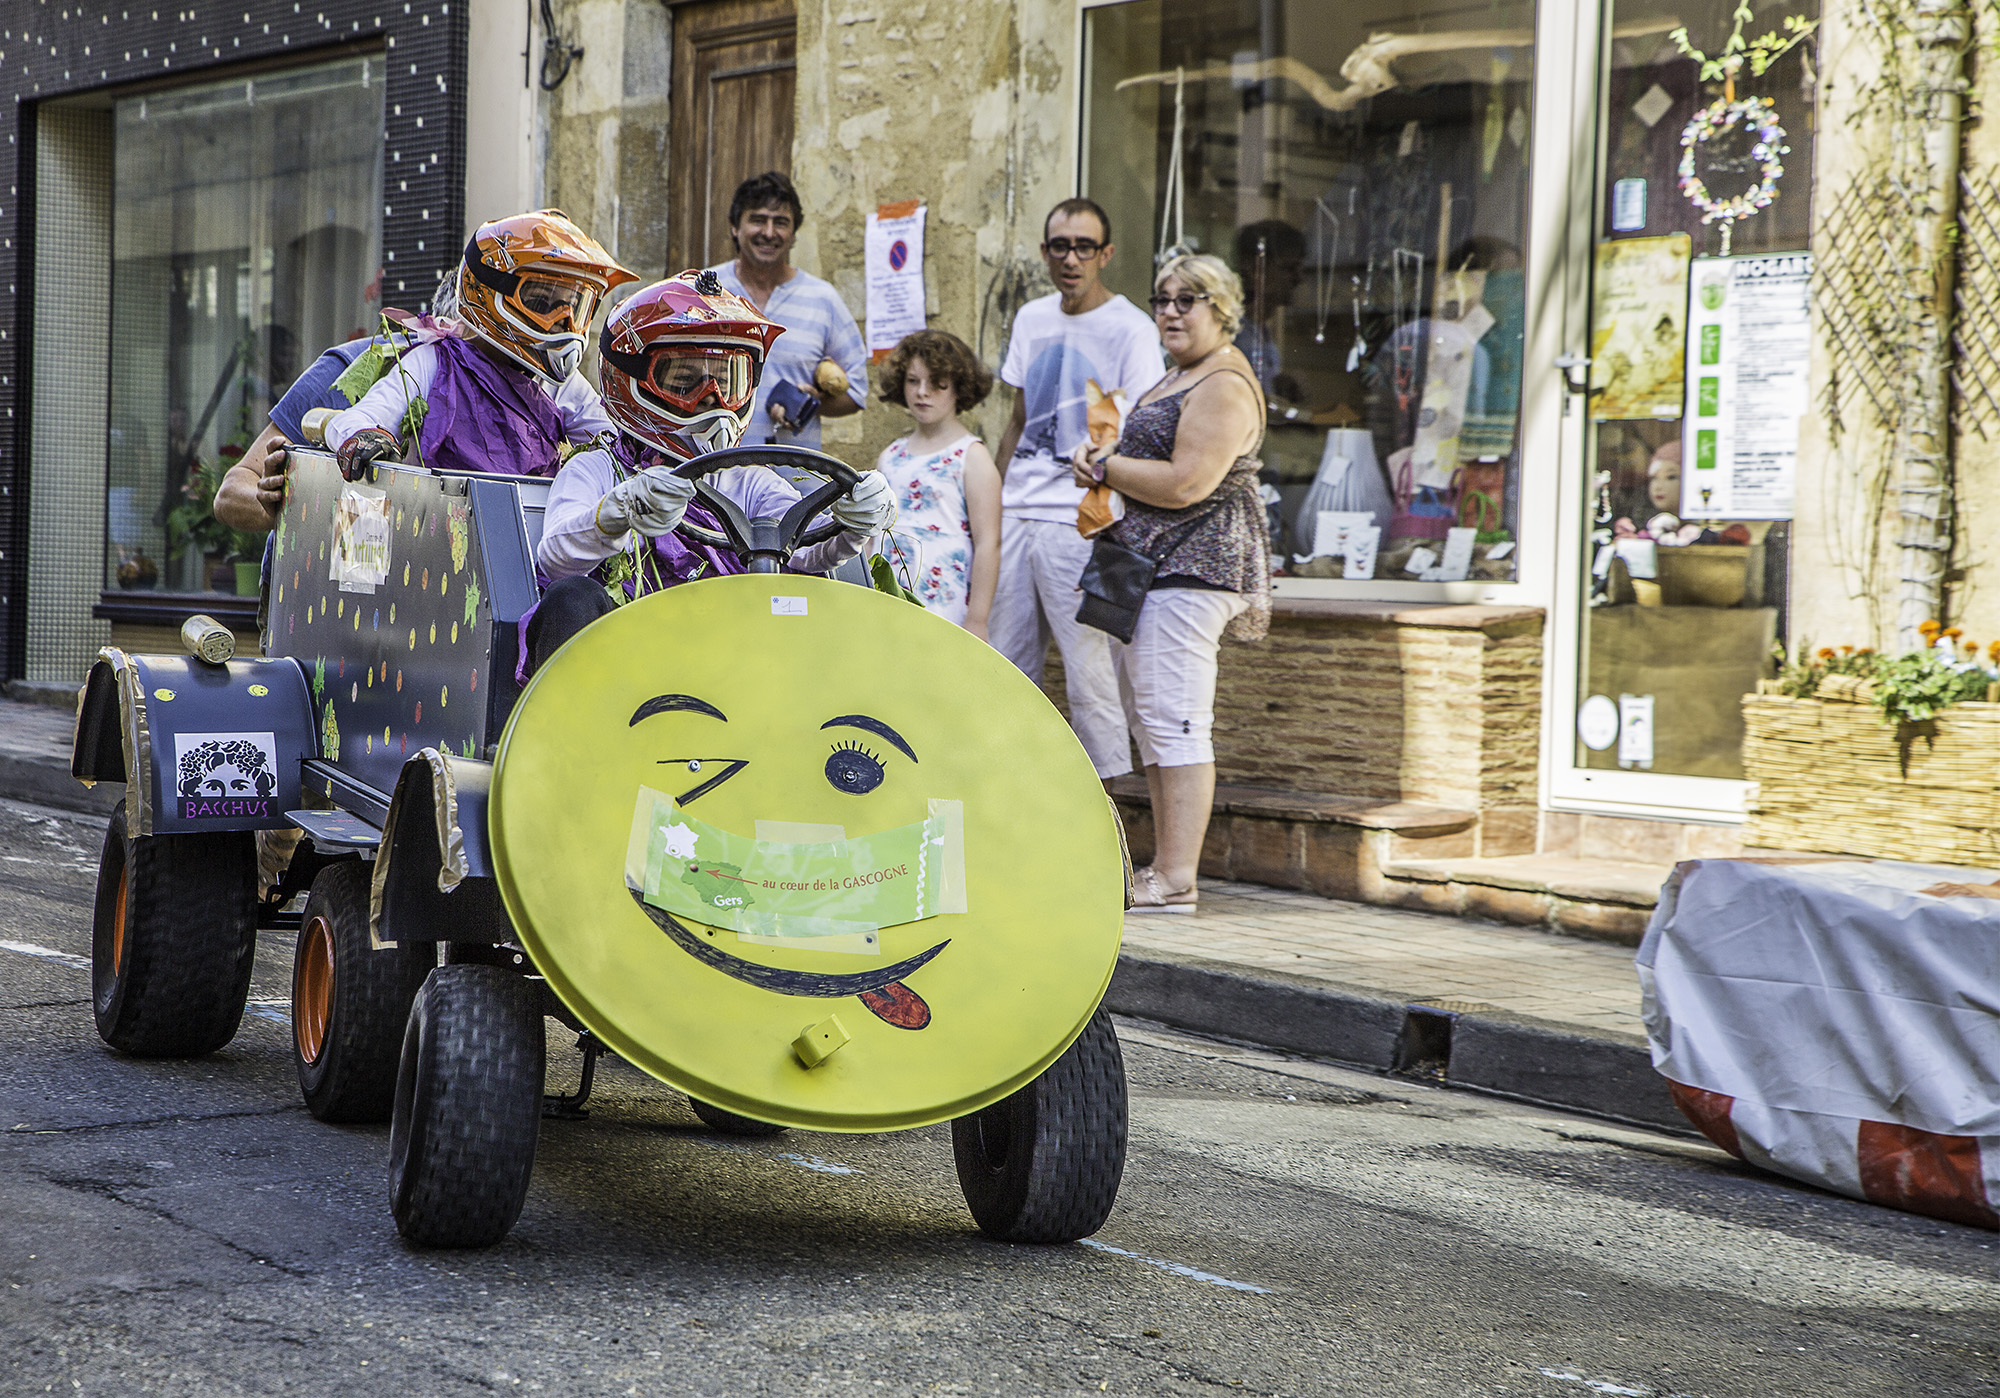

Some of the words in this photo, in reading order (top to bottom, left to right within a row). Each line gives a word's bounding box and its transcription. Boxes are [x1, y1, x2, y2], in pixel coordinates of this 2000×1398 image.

[186, 801, 268, 819] BACCHUS
[762, 879, 776, 889] au
[780, 882, 809, 891] cœur
[813, 879, 826, 891] de
[829, 878, 839, 890] la
[842, 864, 908, 889] GASCOGNE
[713, 894, 744, 906] Gers
